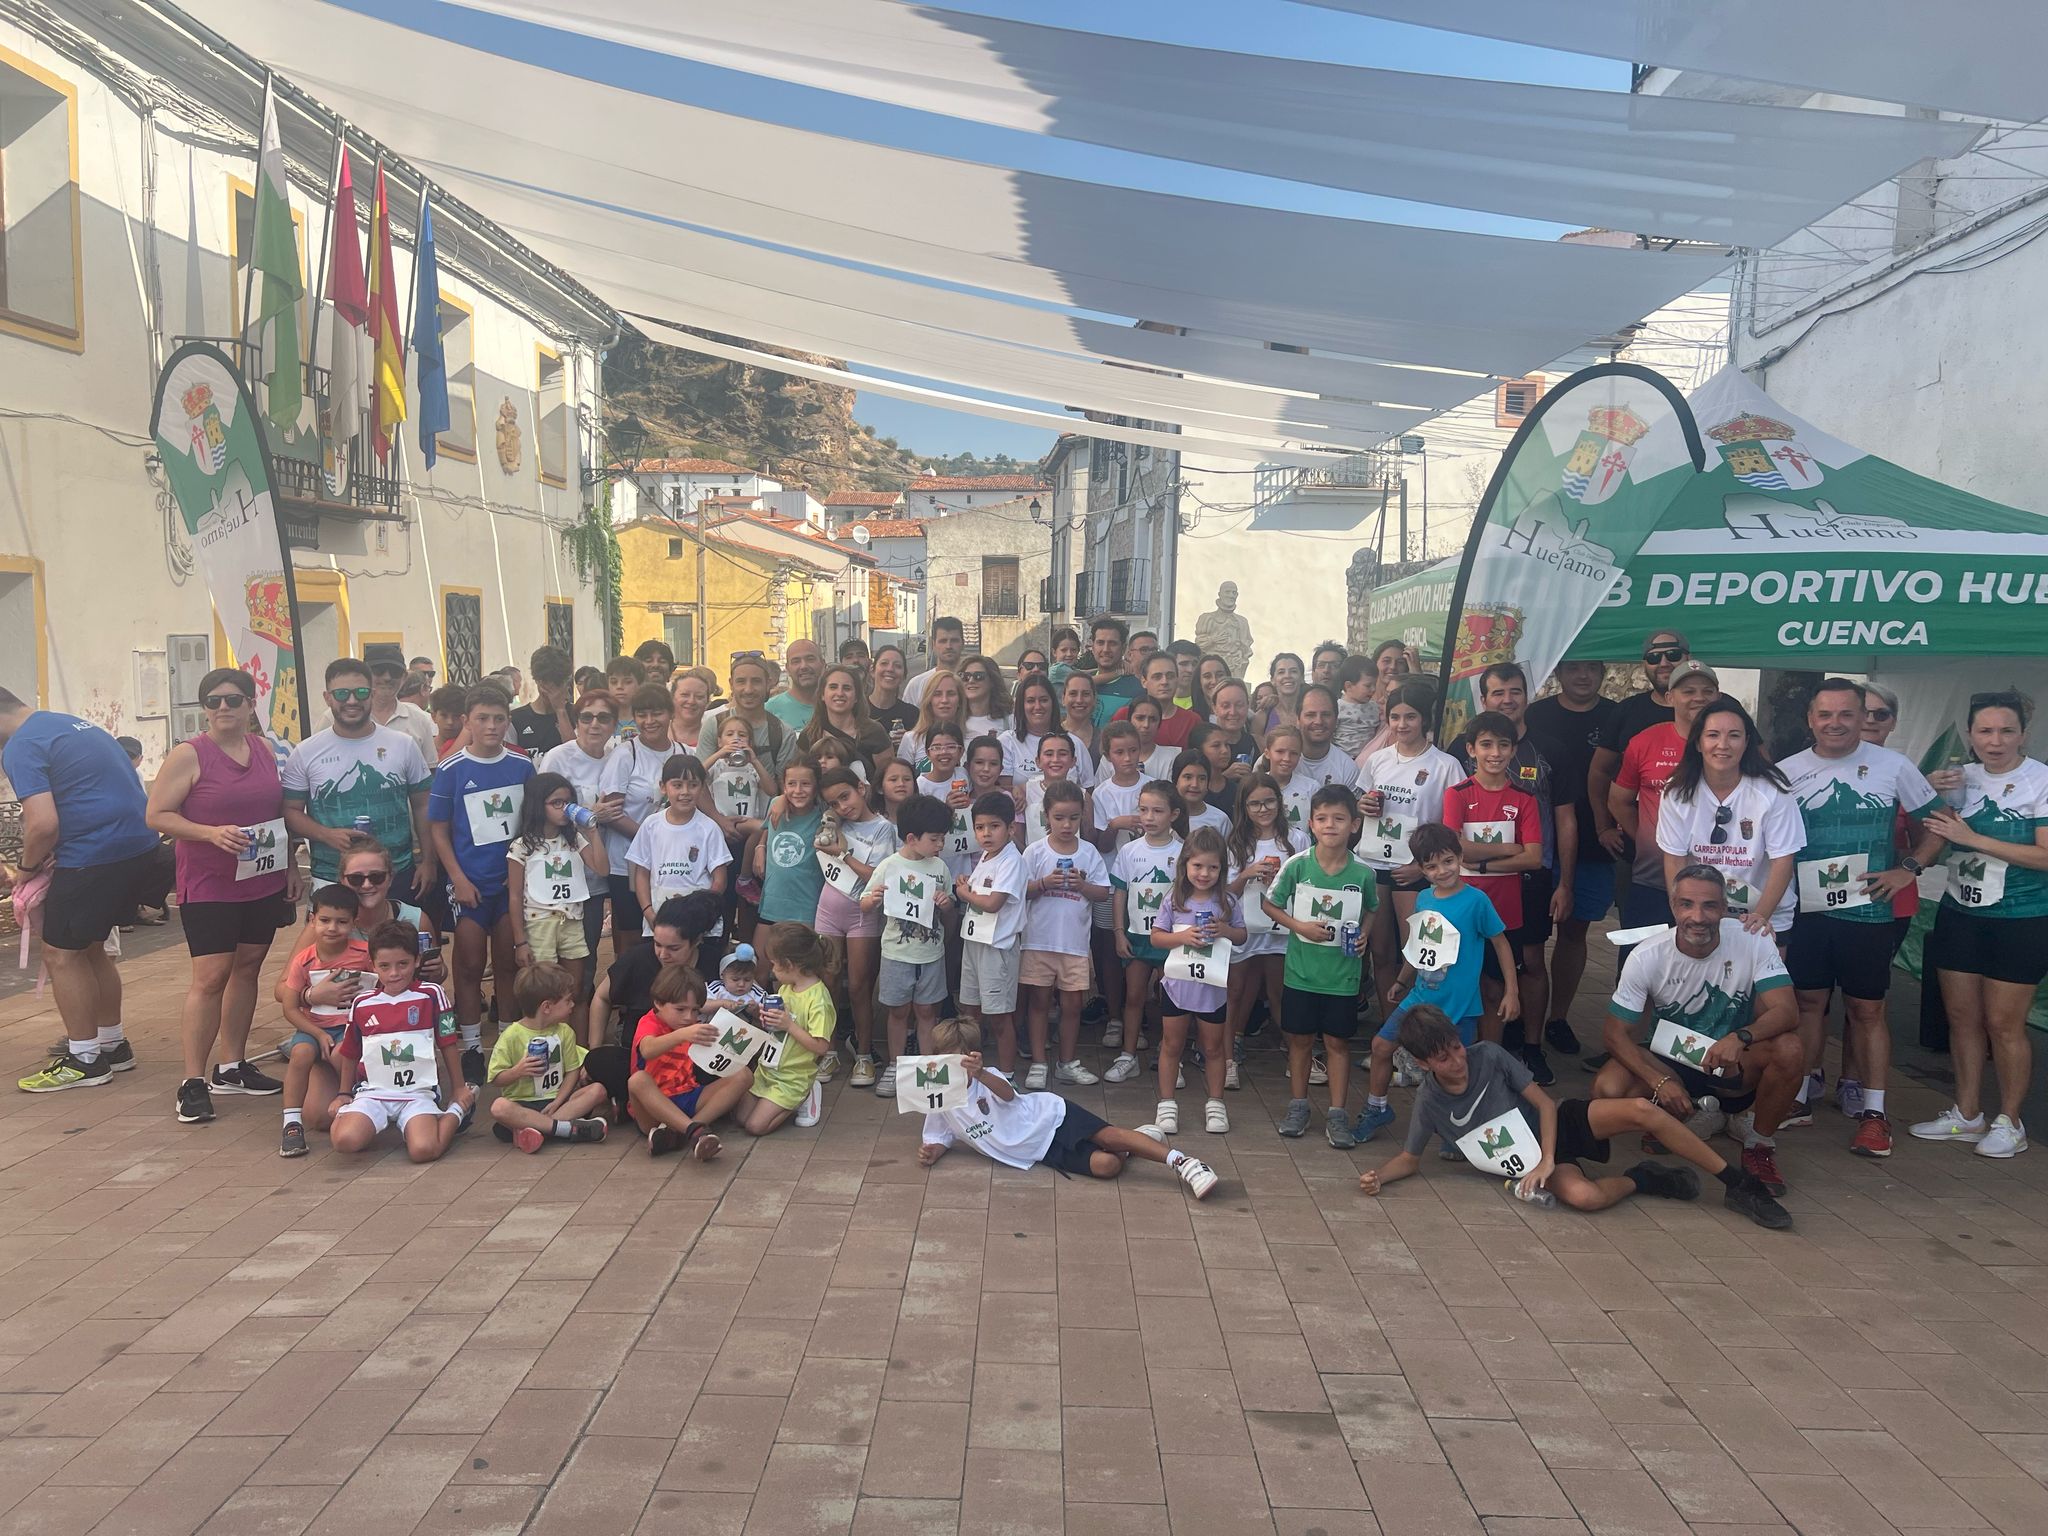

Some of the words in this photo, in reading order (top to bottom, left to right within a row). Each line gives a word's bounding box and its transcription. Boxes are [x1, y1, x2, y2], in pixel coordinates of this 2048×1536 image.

[1645, 569, 1944, 607] DEPORTIVO
[1369, 595, 1387, 624] CLUB
[1387, 584, 1432, 620] DEPORTIVO
[1403, 626, 1428, 648] CUENCA
[1776, 620, 1929, 646] CUENCA
[1376, 784, 1412, 795] ARRERA
[735, 801, 749, 816] 17
[500, 820, 510, 836] 1
[954, 837, 969, 853] 24
[1383, 844, 1392, 858] 3
[255, 854, 275, 872] 176
[825, 862, 842, 882] 36
[551, 884, 571, 900] 25
[1826, 889, 1848, 907] 99
[1959, 883, 1983, 904] 185
[905, 901, 920, 918] 21
[967, 919, 975, 937] 8
[1418, 947, 1437, 967] 23
[1188, 962, 1206, 979] 13
[708, 1053, 732, 1072] 30
[393, 1069, 416, 1088] 42
[542, 1070, 559, 1090] 46
[926, 1092, 943, 1109] 11
[1500, 1153, 1525, 1177] 39
